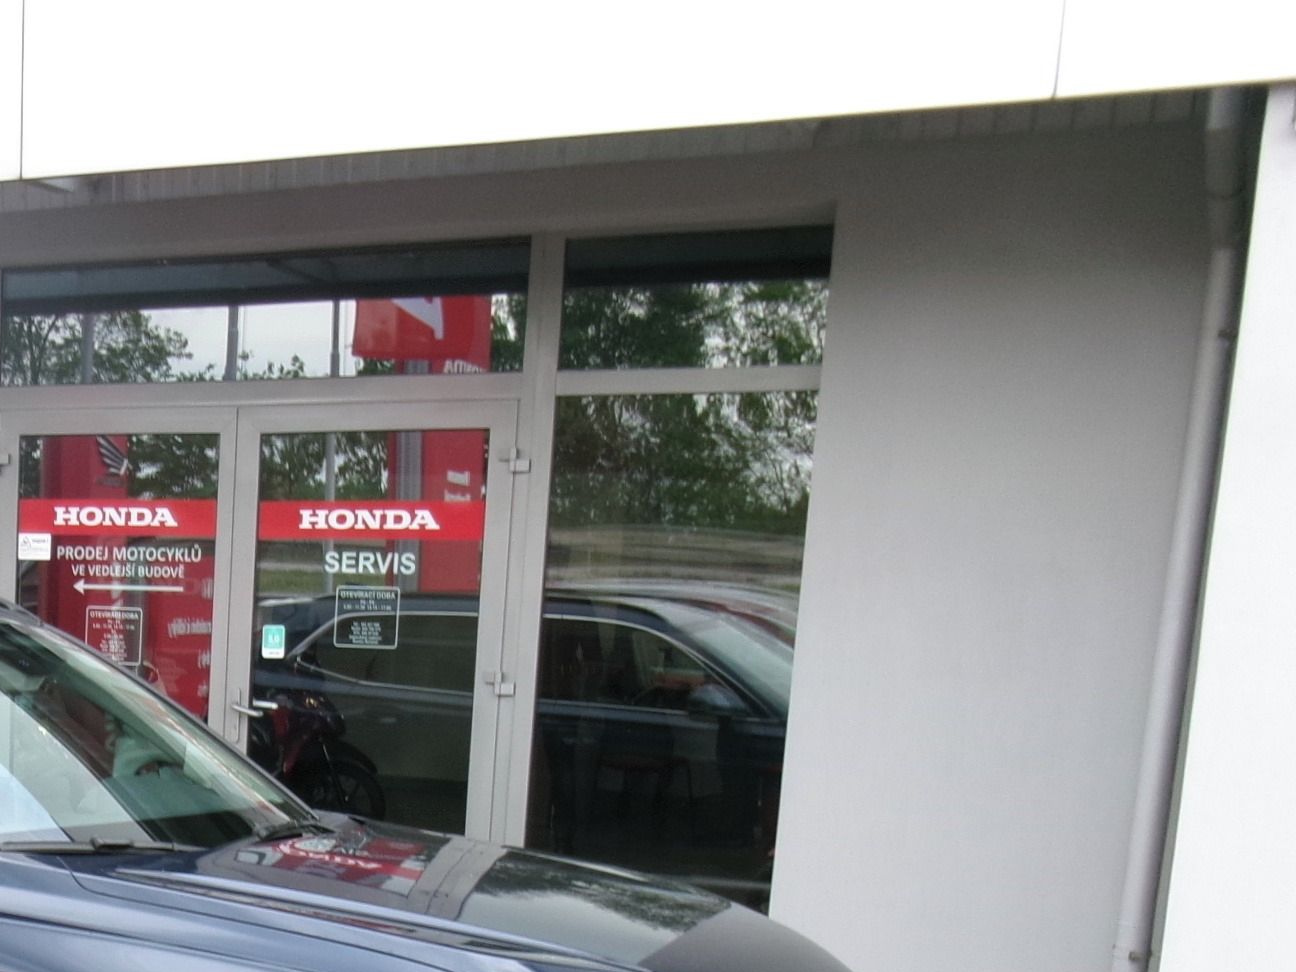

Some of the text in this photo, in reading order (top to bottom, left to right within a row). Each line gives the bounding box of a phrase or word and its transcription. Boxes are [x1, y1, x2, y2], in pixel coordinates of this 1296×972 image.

[53, 506, 179, 527] HONDA
[298, 508, 441, 531] HONDA
[56, 543, 203, 564] PRODEJ MOTOCYKLŮ
[324, 551, 417, 576] SERVIS
[71, 562, 185, 579] VE VEDLEJŠÍ BUDOVĚ
